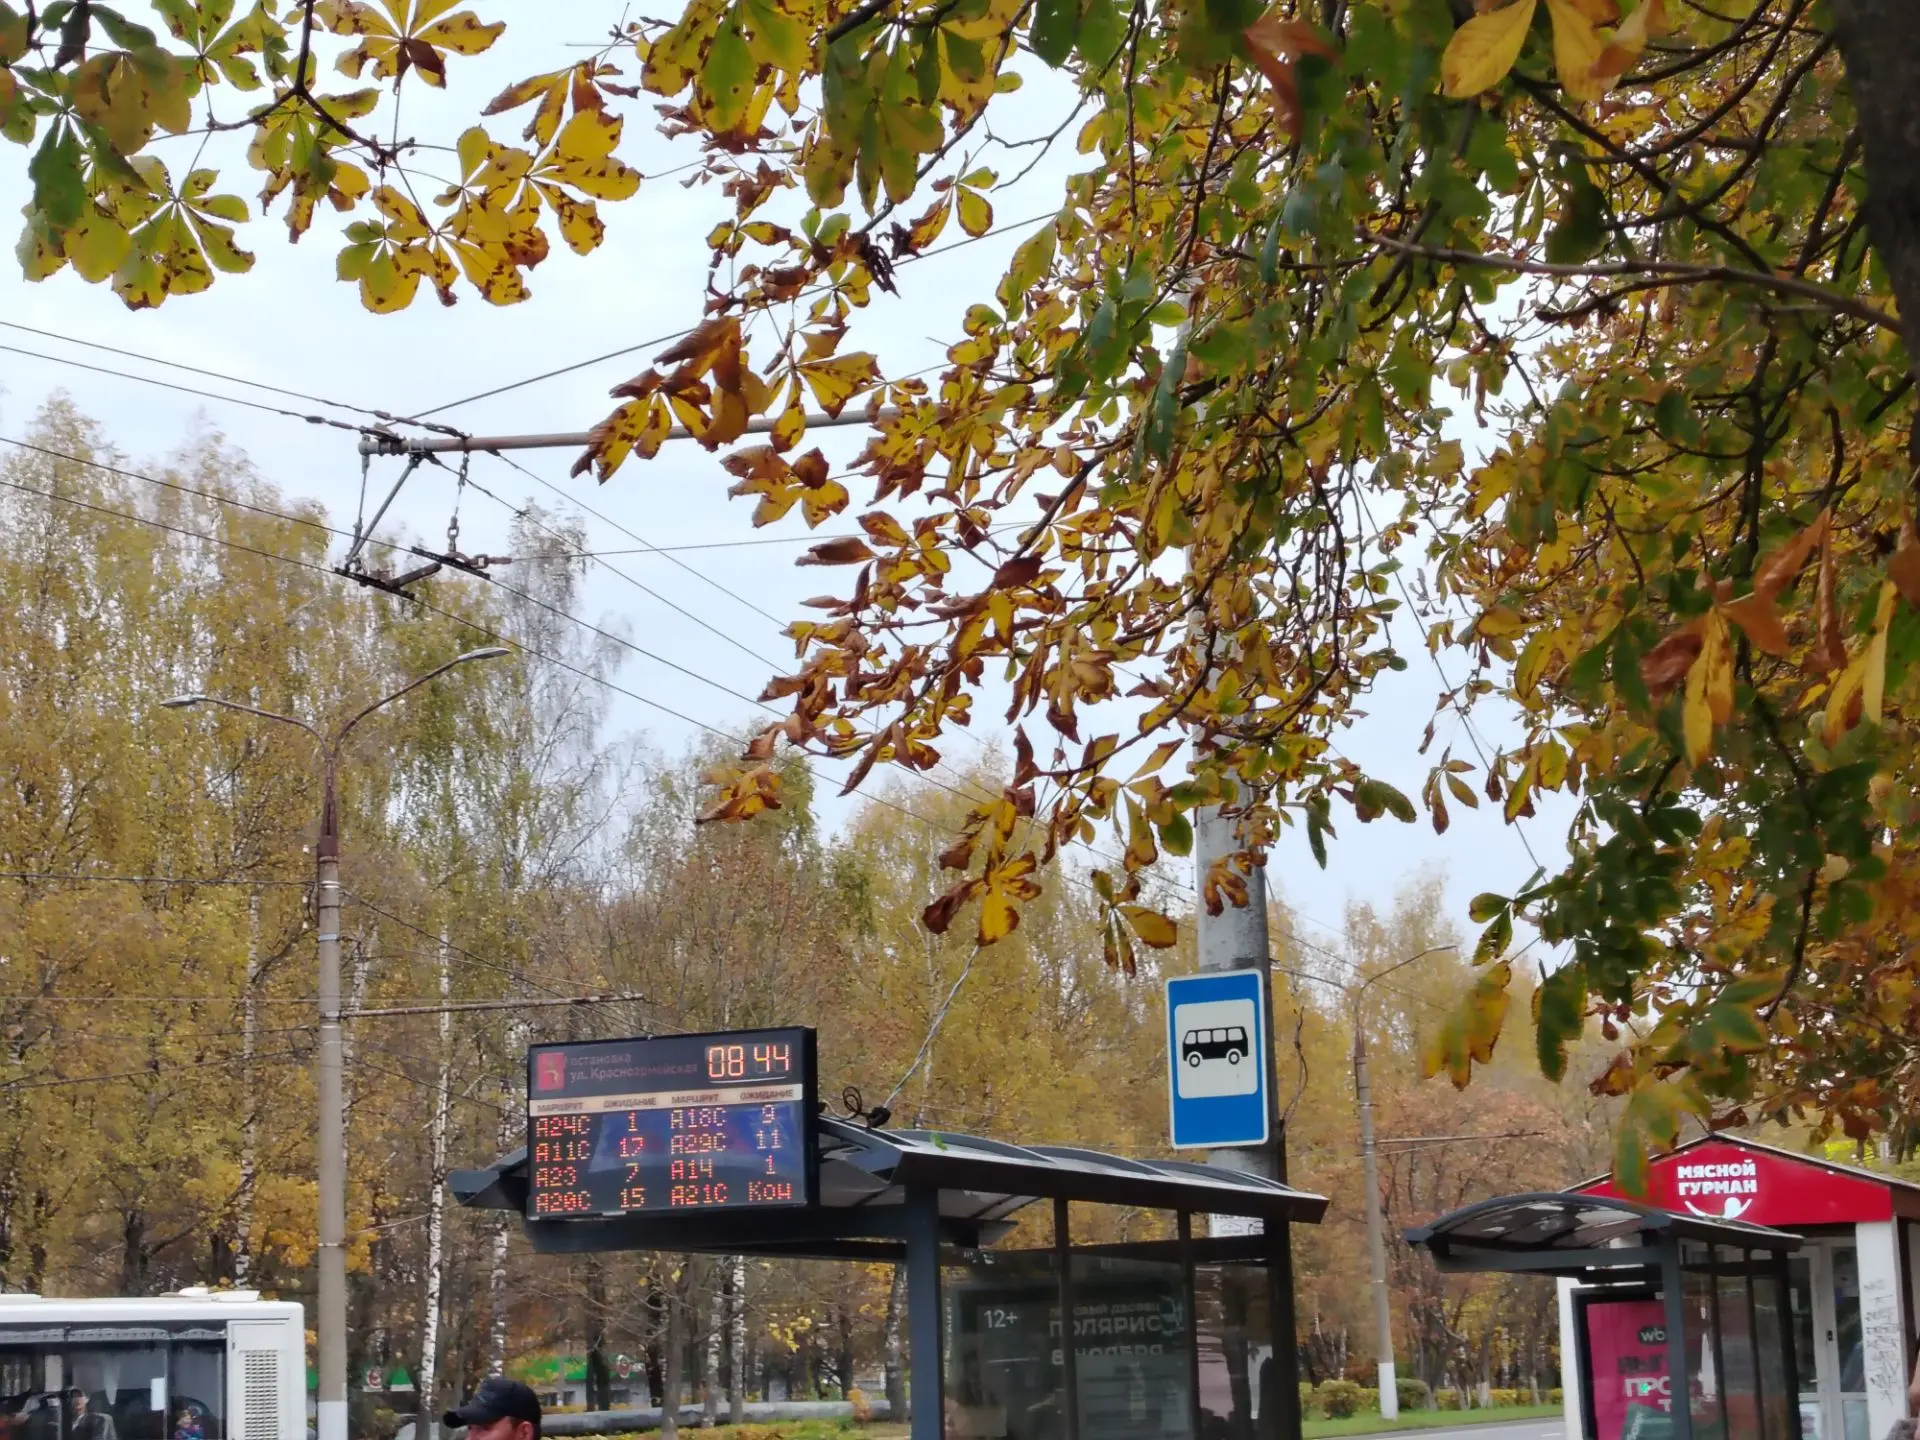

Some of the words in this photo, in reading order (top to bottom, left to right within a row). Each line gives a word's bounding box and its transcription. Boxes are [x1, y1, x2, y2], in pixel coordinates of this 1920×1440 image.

[570, 1053, 632, 1066] остановка
[569, 1070, 588, 1083] ул.
[590, 1063, 698, 1081] Красноармейская
[537, 1101, 584, 1112] МАРШРУТ
[603, 1096, 657, 1109] ОЖИДАНИЕ
[671, 1093, 719, 1105] МАРШРУТ
[739, 1088, 794, 1101] ОЖИДАНИЕ
[628, 1111, 638, 1132] 1
[762, 1104, 775, 1124] 9
[620, 1136, 644, 1157] 17
[756, 1129, 782, 1150] 11
[625, 1162, 639, 1182] 7
[765, 1154, 776, 1175] 1
[1677, 1158, 1756, 1179] МЯСНОЙ
[620, 1187, 645, 1208] 15
[1678, 1179, 1758, 1196] ГУРМАН
[983, 1309, 1019, 1329] 12+
